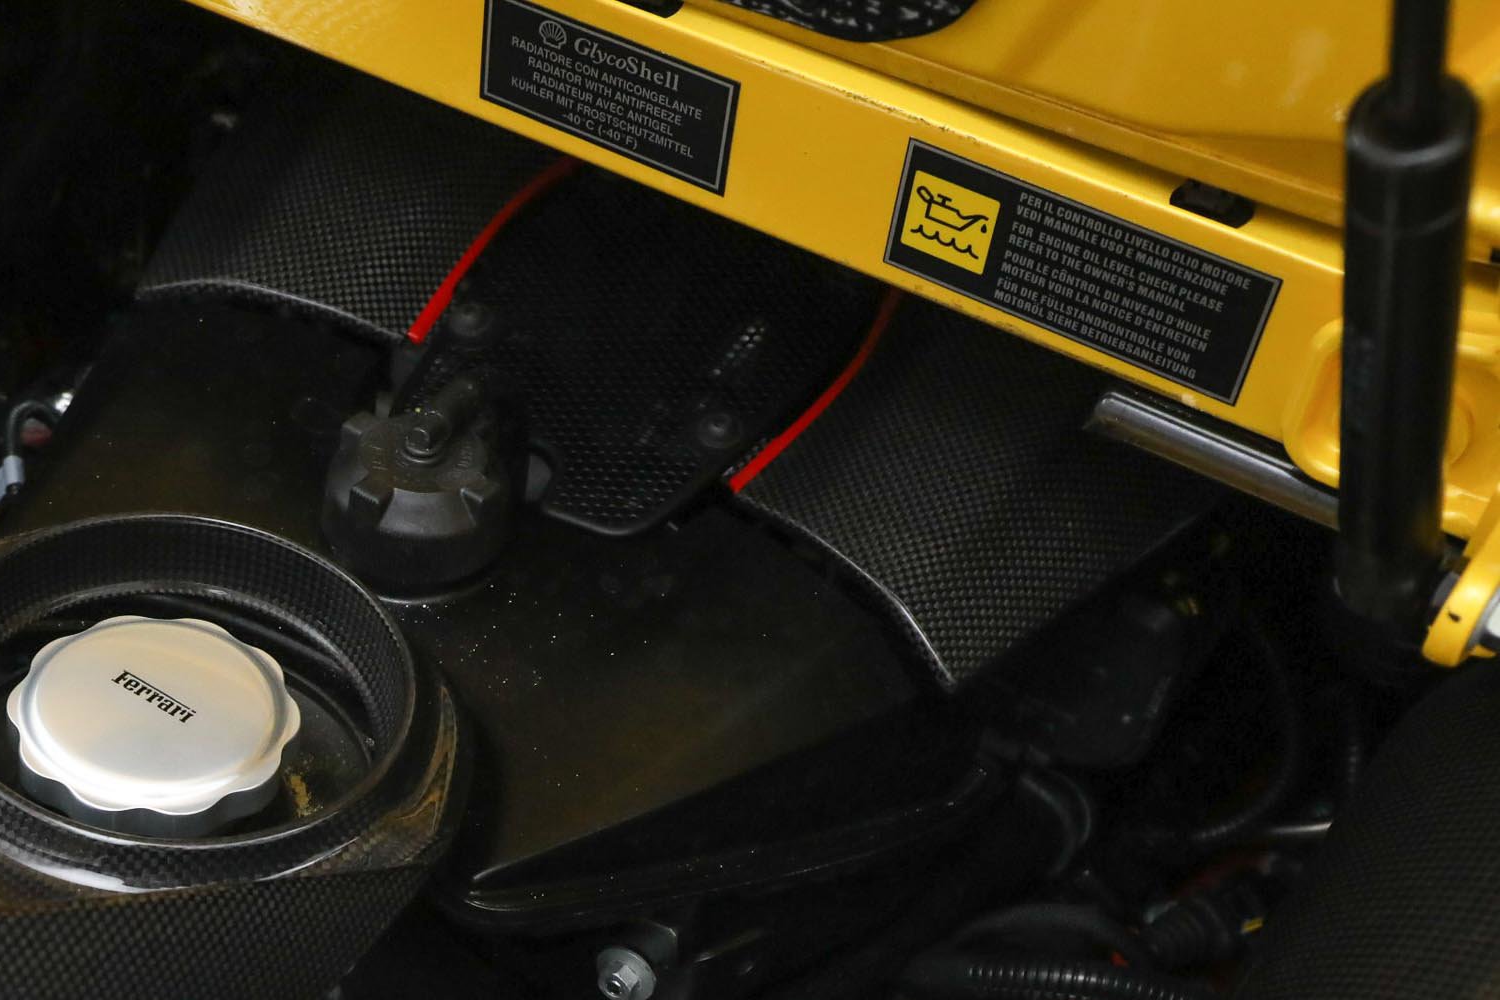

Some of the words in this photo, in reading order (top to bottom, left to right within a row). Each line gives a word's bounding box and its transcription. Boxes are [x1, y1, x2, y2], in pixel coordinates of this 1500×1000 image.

[511, 36, 572, 69] RADIATORE
[575, 62, 599, 78] CON
[601, 72, 703, 120] ANTICONGELANTE
[528, 56, 582, 85] RADIATOR
[585, 79, 612, 98] WITH
[614, 91, 682, 126] ANTIFREEZE
[533, 72, 593, 103] RADIATEUR
[596, 97, 625, 116] AVEC
[627, 110, 673, 137] ANTIGEL
[574, 38, 679, 91] GlycoShell
[511, 75, 554, 101] KUHLER
[556, 95, 574, 109] MIT
[577, 103, 694, 158] FROSTSCHUTZMITTEL
[1008, 234, 1042, 255] REFER
[1046, 247, 1059, 261] TO
[1061, 254, 1082, 271] THE
[1084, 263, 1136, 292] OWNER'S
[1137, 286, 1186, 312] MANUAL
[1012, 221, 1034, 238] FOR
[1038, 232, 1081, 256] ENGINE
[1083, 249, 1101, 265] OIL
[1103, 257, 1135, 279] LEVEL
[1138, 271, 1177, 295] CHECK
[1178, 287, 1224, 313] PLEASE
[1016, 205, 1042, 223] VEDI
[1044, 216, 1098, 245] MANUALE
[1101, 239, 1124, 255] USO
[1126, 248, 1133, 259] E
[1135, 252, 1229, 296] MANUTENZIONE
[1020, 192, 1042, 208] PER
[1044, 201, 1054, 214] IL
[1057, 206, 1123, 240] CONTROLLO
[1125, 231, 1170, 258] LIVELLO
[1172, 251, 1199, 269] OLIO
[1201, 263, 1251, 290] MOTORE
[994, 289, 1044, 318] MOTORÖL
[1046, 310, 1079, 331] SIEHE
[1080, 324, 1197, 380] BETRIEBSANLEITUNG
[997, 275, 1018, 293] FÜR
[1020, 287, 1039, 301] DIE
[1040, 294, 1165, 352] FÜLLSTANDKONTROLLE
[1167, 345, 1191, 363] VON
[1001, 262, 1046, 288] MOTEUR
[1049, 281, 1074, 299] VOIR
[1076, 291, 1089, 305] LA
[1092, 299, 1133, 322] NOTICE
[1134, 314, 1208, 352] D'ENTRETIEN
[1004, 250, 1034, 270] POUR
[1036, 263, 1049, 276] LE
[1104, 290, 1120, 303] DU
[1122, 296, 1164, 321] NIVEAU
[1166, 314, 1212, 340] D'HUILE
[111, 669, 196, 723] Ferrari
